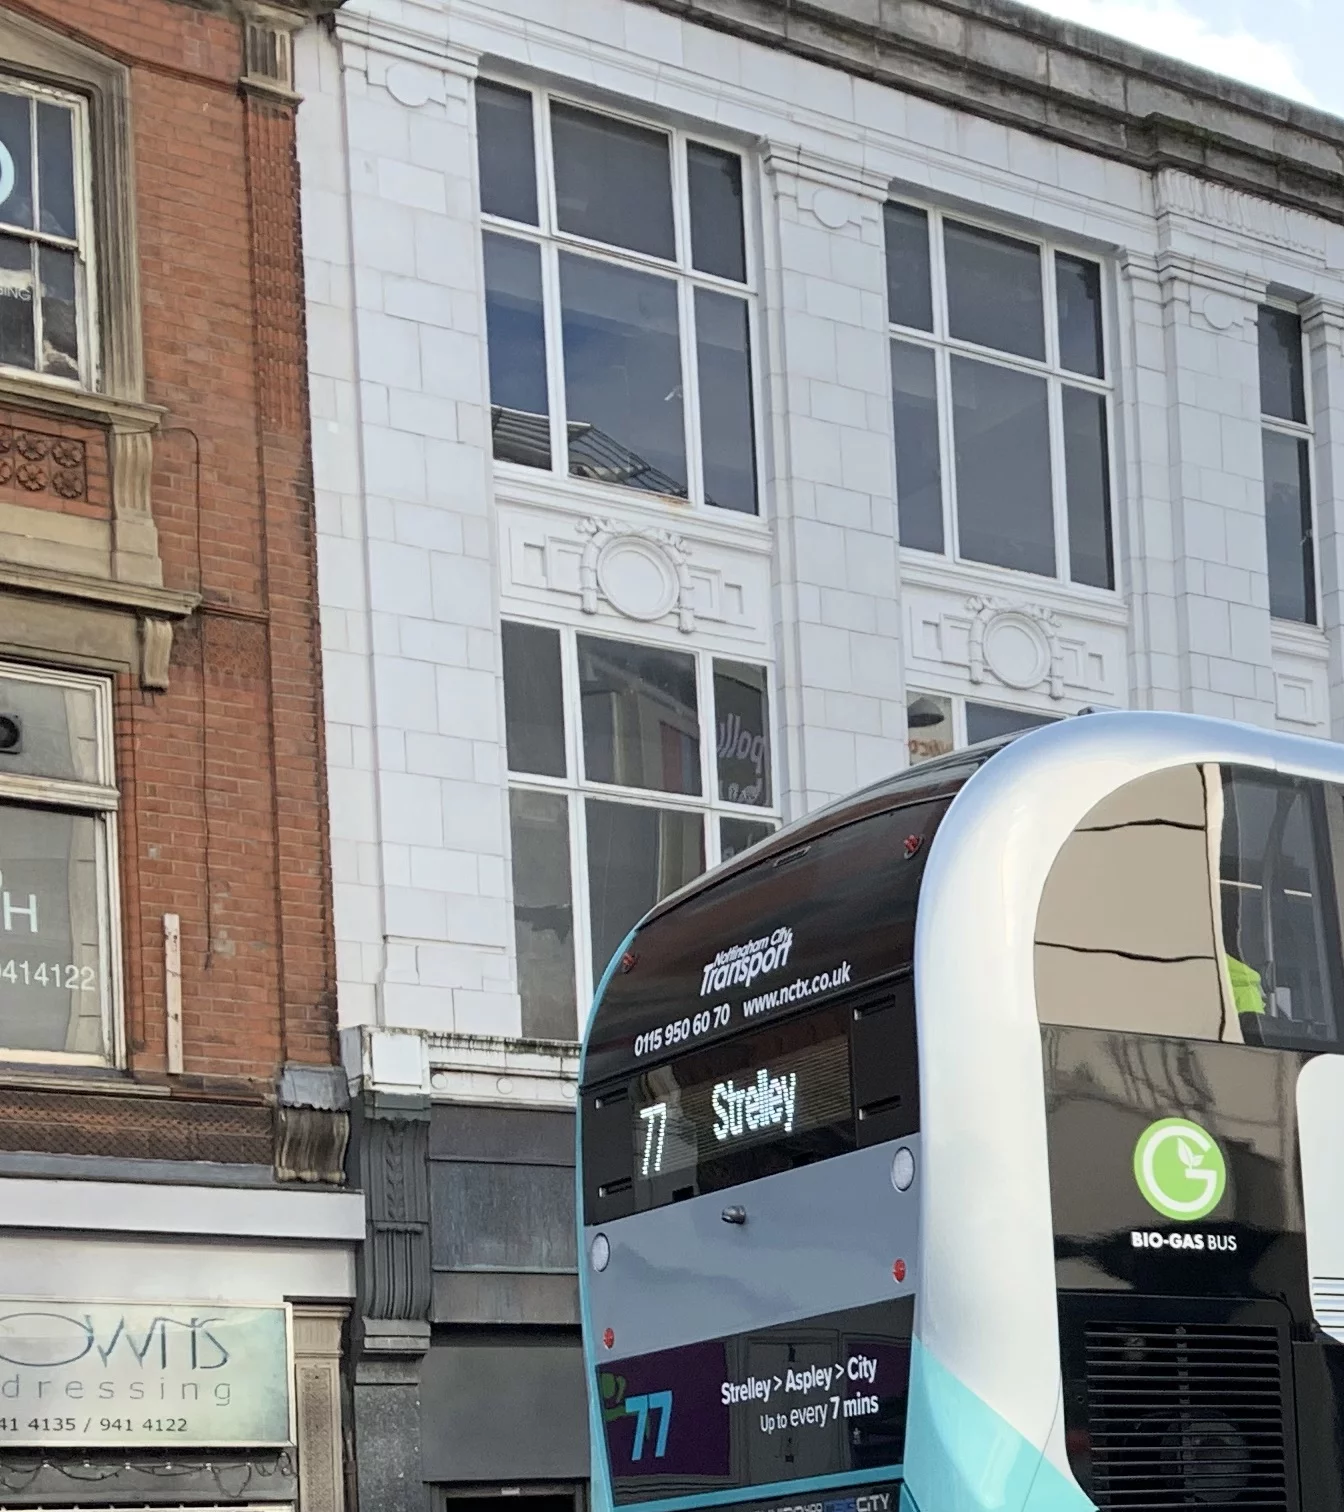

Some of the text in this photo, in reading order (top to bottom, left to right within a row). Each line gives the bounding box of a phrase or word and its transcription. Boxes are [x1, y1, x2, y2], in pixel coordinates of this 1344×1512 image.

[700, 932, 793, 997] Transport
[714, 926, 793, 967] Nottingham City
[0, 959, 96, 992] 414122
[634, 960, 852, 1057] 0115 950 60 70 www.nctx.co.uk
[639, 1069, 797, 1176] 77 Strelley
[1131, 1231, 1237, 1251] BIO-GAS BUS
[1, 1374, 231, 1406] dressing
[721, 1376, 771, 1406] Strelley
[785, 1364, 833, 1395] Aspley
[847, 1354, 878, 1383] City
[28, 1418, 76, 1432] 4135
[100, 1418, 133, 1432] 941
[142, 1418, 188, 1432] 4122
[625, 1390, 673, 1461] 77
[760, 1391, 879, 1435] Up to every 7 mins
